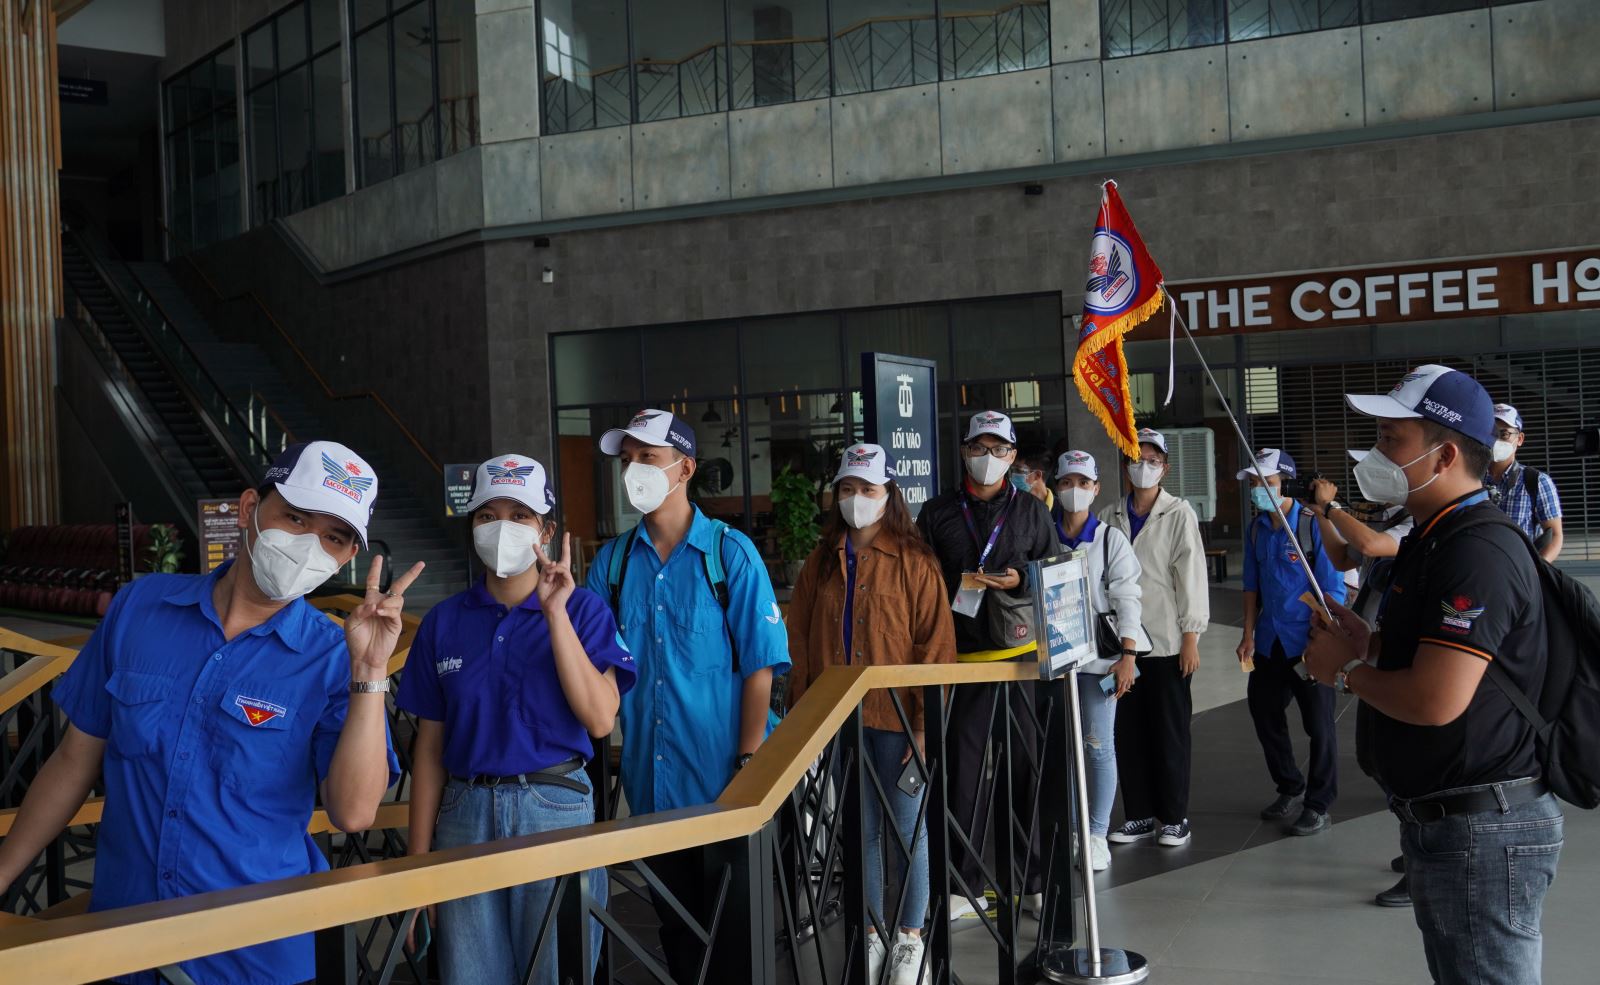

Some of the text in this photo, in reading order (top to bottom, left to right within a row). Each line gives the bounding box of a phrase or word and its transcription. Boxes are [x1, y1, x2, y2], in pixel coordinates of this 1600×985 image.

[1180, 286, 1272, 330] THE
[1290, 266, 1499, 322] COFFEE
[892, 427, 921, 449] LỐI VÀO
[896, 455, 912, 477] CÁP
[912, 460, 931, 477] TREO
[325, 478, 361, 501] SACOTRAVEL
[907, 482, 928, 504] CHÙA
